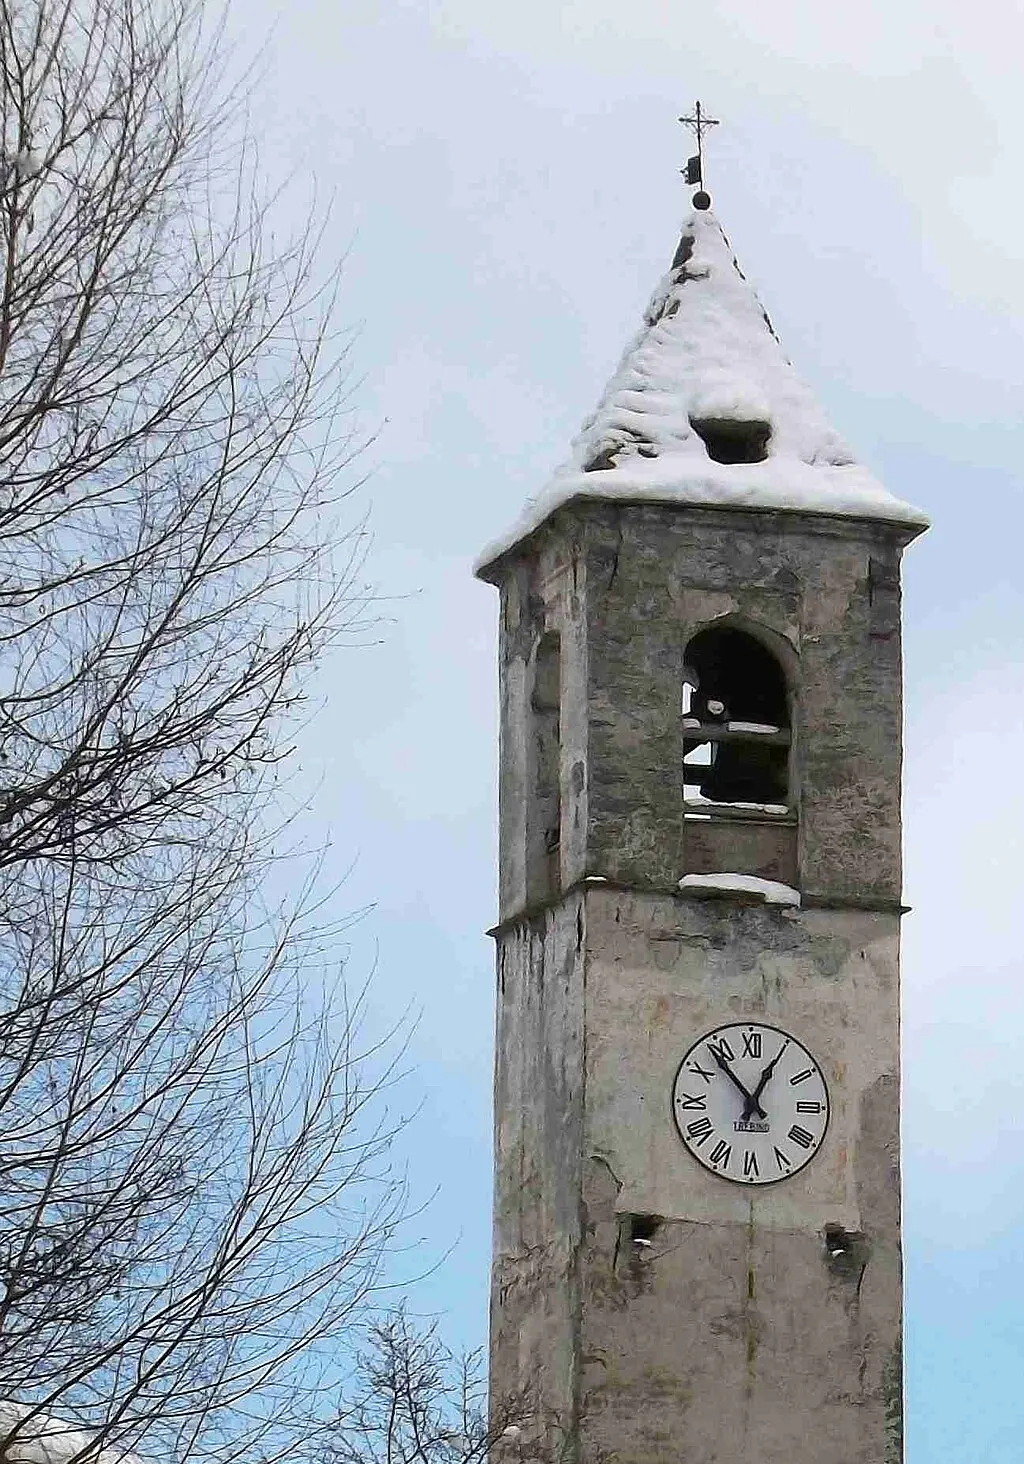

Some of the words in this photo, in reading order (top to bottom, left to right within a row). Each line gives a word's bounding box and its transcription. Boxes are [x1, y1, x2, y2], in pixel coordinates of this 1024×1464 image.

[742, 1033, 761, 1058] XII
[689, 1061, 716, 1084] X
[790, 1069, 812, 1085] II
[682, 1093, 707, 1110] IX
[796, 1101, 820, 1113] III
[687, 1117, 715, 1147] VIII
[709, 1140, 732, 1169] VII
[743, 1150, 759, 1176] VI
[773, 1146, 791, 1171] V
